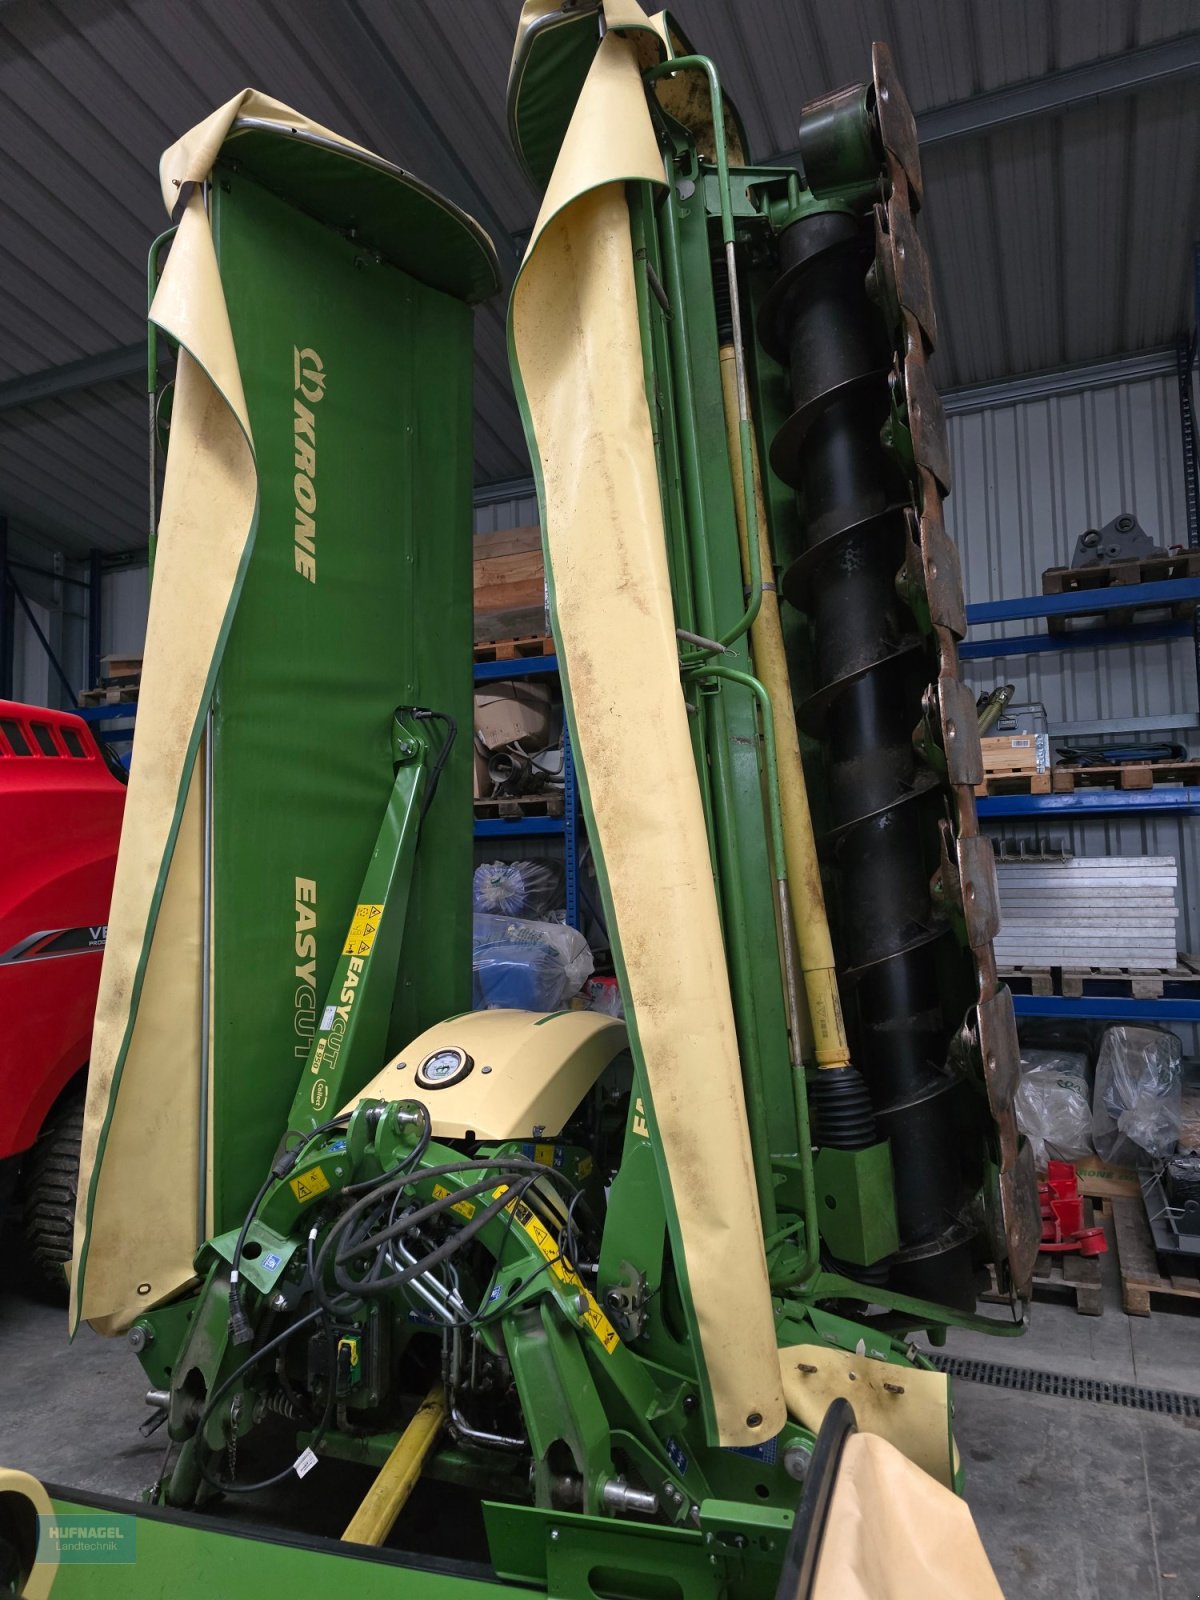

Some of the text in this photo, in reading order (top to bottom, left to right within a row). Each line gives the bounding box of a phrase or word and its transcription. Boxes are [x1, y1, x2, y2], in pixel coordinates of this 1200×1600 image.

[294, 397, 317, 584] KRONE
[294, 876, 317, 1058] EASYCUT
[323, 956, 364, 1070] EASYCUT
[313, 1052, 323, 1069] 950
